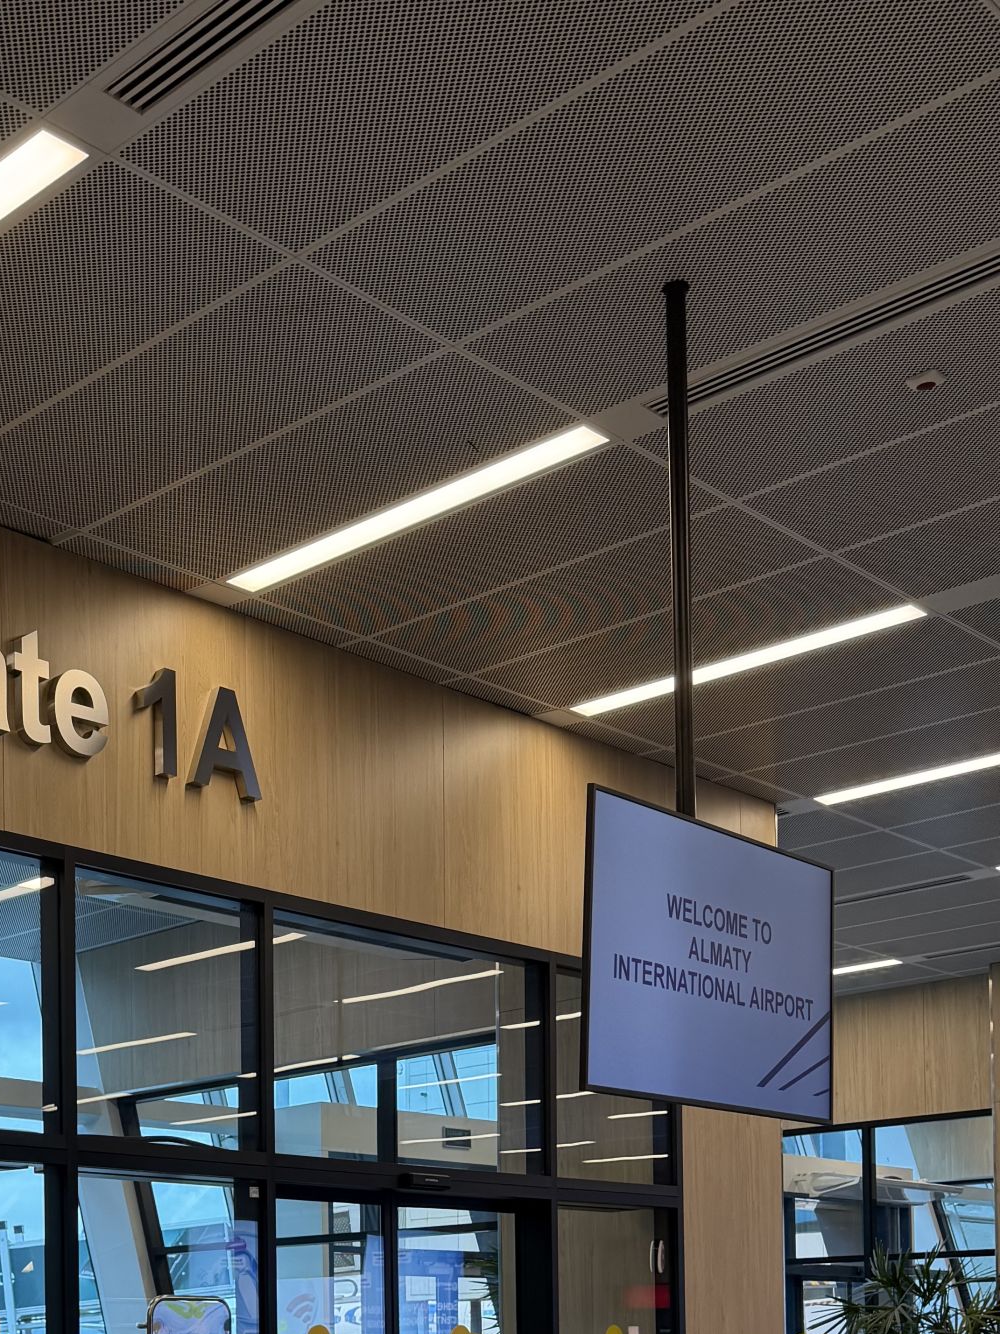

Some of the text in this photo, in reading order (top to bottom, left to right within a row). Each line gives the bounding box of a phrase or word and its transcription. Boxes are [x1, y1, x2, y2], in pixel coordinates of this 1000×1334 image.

[133, 668, 262, 803] 1A
[667, 893, 772, 944] WELCOME TO
[688, 936, 752, 973] ALMATY
[613, 953, 814, 1021] INTERNATIONAL AIRPORT
